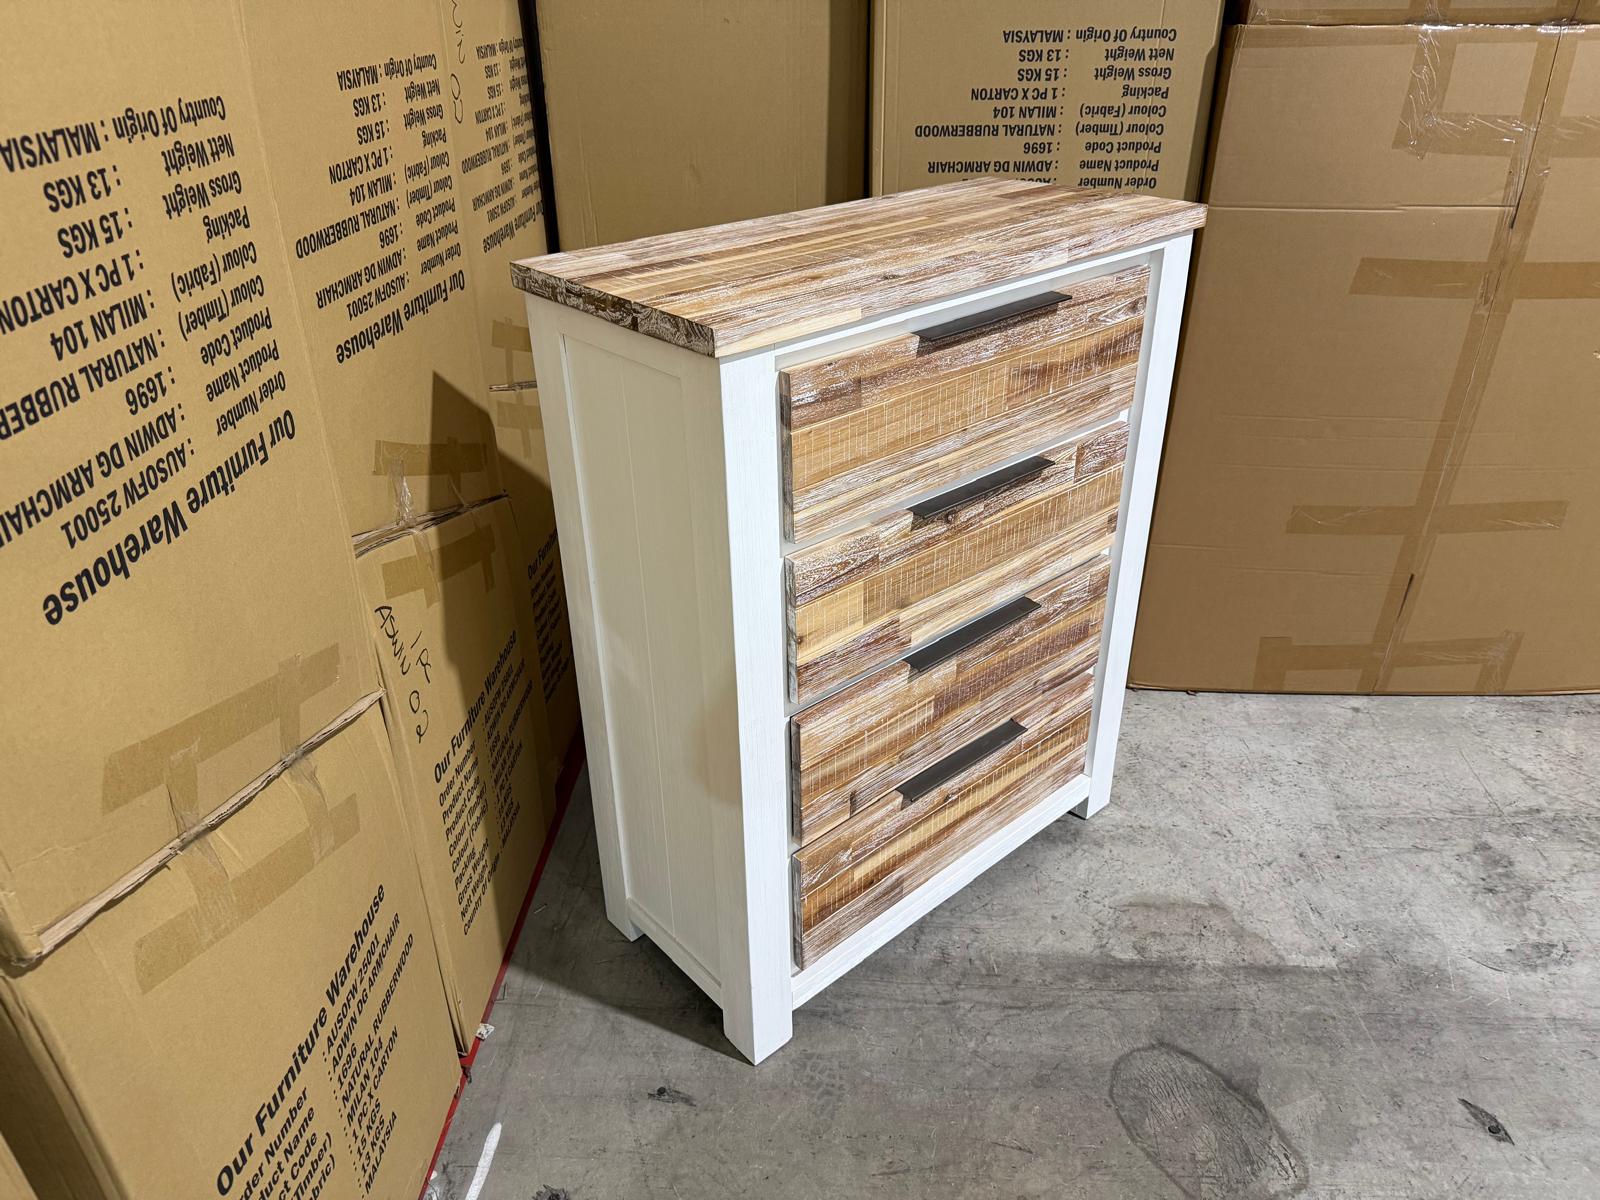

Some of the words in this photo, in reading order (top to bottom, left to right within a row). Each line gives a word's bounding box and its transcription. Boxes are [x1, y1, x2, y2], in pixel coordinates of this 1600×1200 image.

[1002, 29, 1064, 44] MALAYSIA
[1075, 26, 1112, 43] Origin
[1112, 29, 1128, 43] Of
[1129, 25, 1177, 42] Country
[412, 53, 437, 73] Country
[1018, 49, 1044, 63] KGS
[1046, 48, 1062, 62] 13
[1104, 45, 1146, 62] Weight
[1148, 47, 1175, 61] Nett
[336, 64, 379, 92] MALAYSIA
[383, 57, 405, 80] Origin
[404, 58, 413, 77] Of
[1017, 68, 1042, 82] KGS
[1044, 67, 1060, 82] 15
[1094, 64, 1135, 81] Weight
[1138, 67, 1172, 81] Gross
[404, 80, 428, 104] Weight
[425, 78, 441, 98] Nett
[970, 87, 1019, 101] CARTON
[1021, 87, 1030, 101] X
[1031, 87, 1048, 101] PC
[1051, 87, 1059, 100] 1
[1120, 83, 1170, 100] Packing
[177, 95, 226, 127] Country
[352, 95, 371, 118] KGS
[370, 93, 382, 113] 13
[425, 103, 444, 120] Gross
[992, 106, 1016, 119] 104
[1018, 105, 1057, 119] MILAN
[1079, 102, 1126, 119] (Fabric)
[1127, 105, 1167, 118] Colour
[111, 107, 160, 144] Origin
[159, 106, 178, 136] Of
[374, 120, 386, 140] 15
[402, 107, 427, 131] Weight
[914, 124, 1000, 138] RUBBERWOOD
[1001, 124, 1056, 137] NATURAL
[1075, 120, 1124, 136] (Timber)
[1125, 123, 1164, 136] Colour
[0, 121, 102, 173] MALAYSIA
[206, 133, 235, 163] Nett
[356, 123, 375, 146] KGS
[421, 127, 447, 149] Packing
[1023, 141, 1053, 155] 1696
[1084, 141, 1114, 154] Code
[1116, 141, 1162, 154] Product
[160, 140, 210, 177] Weight
[328, 155, 364, 185] CARTON
[370, 149, 383, 170] PC
[404, 155, 430, 184] (Fabric)
[430, 151, 450, 170] Colour
[927, 160, 992, 174] ARMCHAIR
[993, 160, 1010, 173] DG
[1012, 160, 1053, 173] ADWIN
[1079, 159, 1112, 172] Name
[1114, 159, 1160, 172] Product
[43, 174, 87, 213] KGS
[86, 167, 112, 200] 13
[208, 170, 242, 198] Gross
[349, 183, 366, 206] 104
[366, 173, 393, 200] MILAN
[406, 179, 433, 209] (Timber)
[433, 174, 453, 194] Colour
[1077, 177, 1123, 191] Number
[1124, 177, 1157, 190] Order
[161, 182, 211, 220] Weight
[359, 199, 397, 229] NATURAL
[431, 197, 456, 222] Product
[99, 210, 124, 245] 15
[202, 205, 251, 244] Packing
[415, 208, 433, 229] Code
[434, 219, 459, 245] Product
[57, 219, 100, 259] KGS
[295, 214, 361, 259] RUBBERWOOD
[378, 224, 399, 249] 1696
[416, 231, 436, 252] Name
[221, 241, 257, 274] Colour
[376, 249, 402, 277] ADWIN
[420, 251, 445, 275] Number
[444, 242, 462, 261] Order
[95, 258, 123, 293] PC
[120, 253, 135, 281] 1
[170, 253, 221, 303] (Fabric)
[363, 262, 377, 284] DG
[77, 268, 97, 300] X
[229, 274, 265, 308] Colour
[315, 269, 363, 309] ARMCHAIR
[374, 272, 406, 306] AUSOFW
[449, 269, 465, 293] Our
[0, 276, 79, 335] CARTON
[346, 291, 374, 321] 25001
[403, 279, 449, 322] Furniture
[89, 293, 148, 343] MILAN
[178, 288, 230, 342] (Timber)
[229, 306, 273, 350] Product
[49, 320, 89, 362] 104
[335, 308, 404, 364] Warehouse
[77, 332, 159, 393] NATURAL
[200, 333, 232, 367] Code
[237, 339, 280, 383] Product
[125, 370, 167, 416] 1696
[205, 366, 241, 402] Name
[258, 370, 286, 404] Order
[216, 390, 260, 437] Number
[123, 407, 177, 462] ADWIN
[268, 409, 296, 449] Our
[95, 442, 125, 478] DG
[186, 431, 269, 514] Furniture
[122, 442, 187, 510] AUSOFW
[0, 459, 95, 548] ARMCHAI
[60, 489, 122, 549] 25001
[42, 500, 188, 626] Warehouse
[216, 1132, 254, 1196] Our
[254, 1006, 328, 1137] Furniture
[325, 884, 385, 1007] Warehouse
[264, 1086, 307, 1165] Number
[326, 978, 358, 1055] AUSOFW
[357, 933, 380, 986] 25001
[283, 1107, 315, 1164] Name
[332, 1011, 358, 1074] ADWIN
[356, 987, 369, 1016] DG
[368, 912, 400, 993] ARMCHAIR
[290, 1131, 332, 1200] Timber)
[341, 1034, 375, 1109] NATURAL
[372, 933, 414, 1036] RUBBERWOOD
[357, 1101, 369, 1131] PC
[372, 1026, 398, 1091] CARTON
[346, 1068, 371, 1128] MILAN
[369, 1036, 383, 1072] 104
[290, 1132, 317, 1181] Code
[337, 1042, 357, 1091] 1696
[356, 1133, 367, 1162] 15
[366, 1097, 381, 1137] KGS
[361, 1150, 371, 1178] 13
[370, 1114, 385, 1154] KGS
[364, 1111, 397, 1195] MALAYSIA
